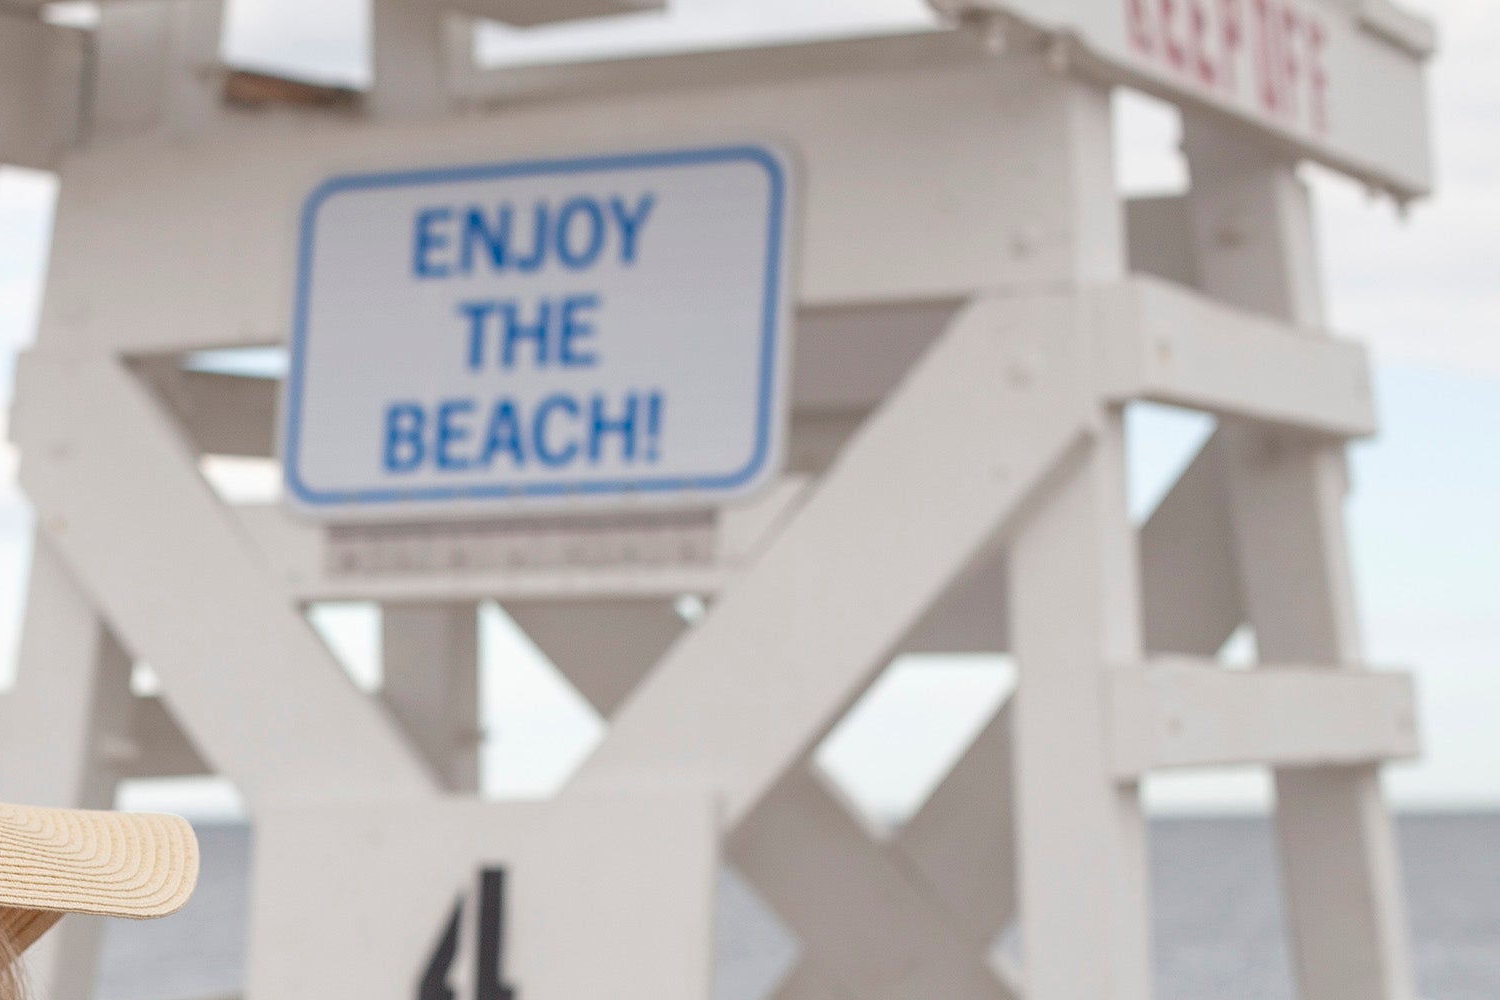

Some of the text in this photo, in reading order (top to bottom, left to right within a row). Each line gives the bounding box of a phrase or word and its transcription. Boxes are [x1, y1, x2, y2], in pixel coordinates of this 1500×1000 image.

[411, 193, 654, 279] ENJOY
[457, 292, 600, 371] THE
[381, 390, 664, 475] BEACH!
